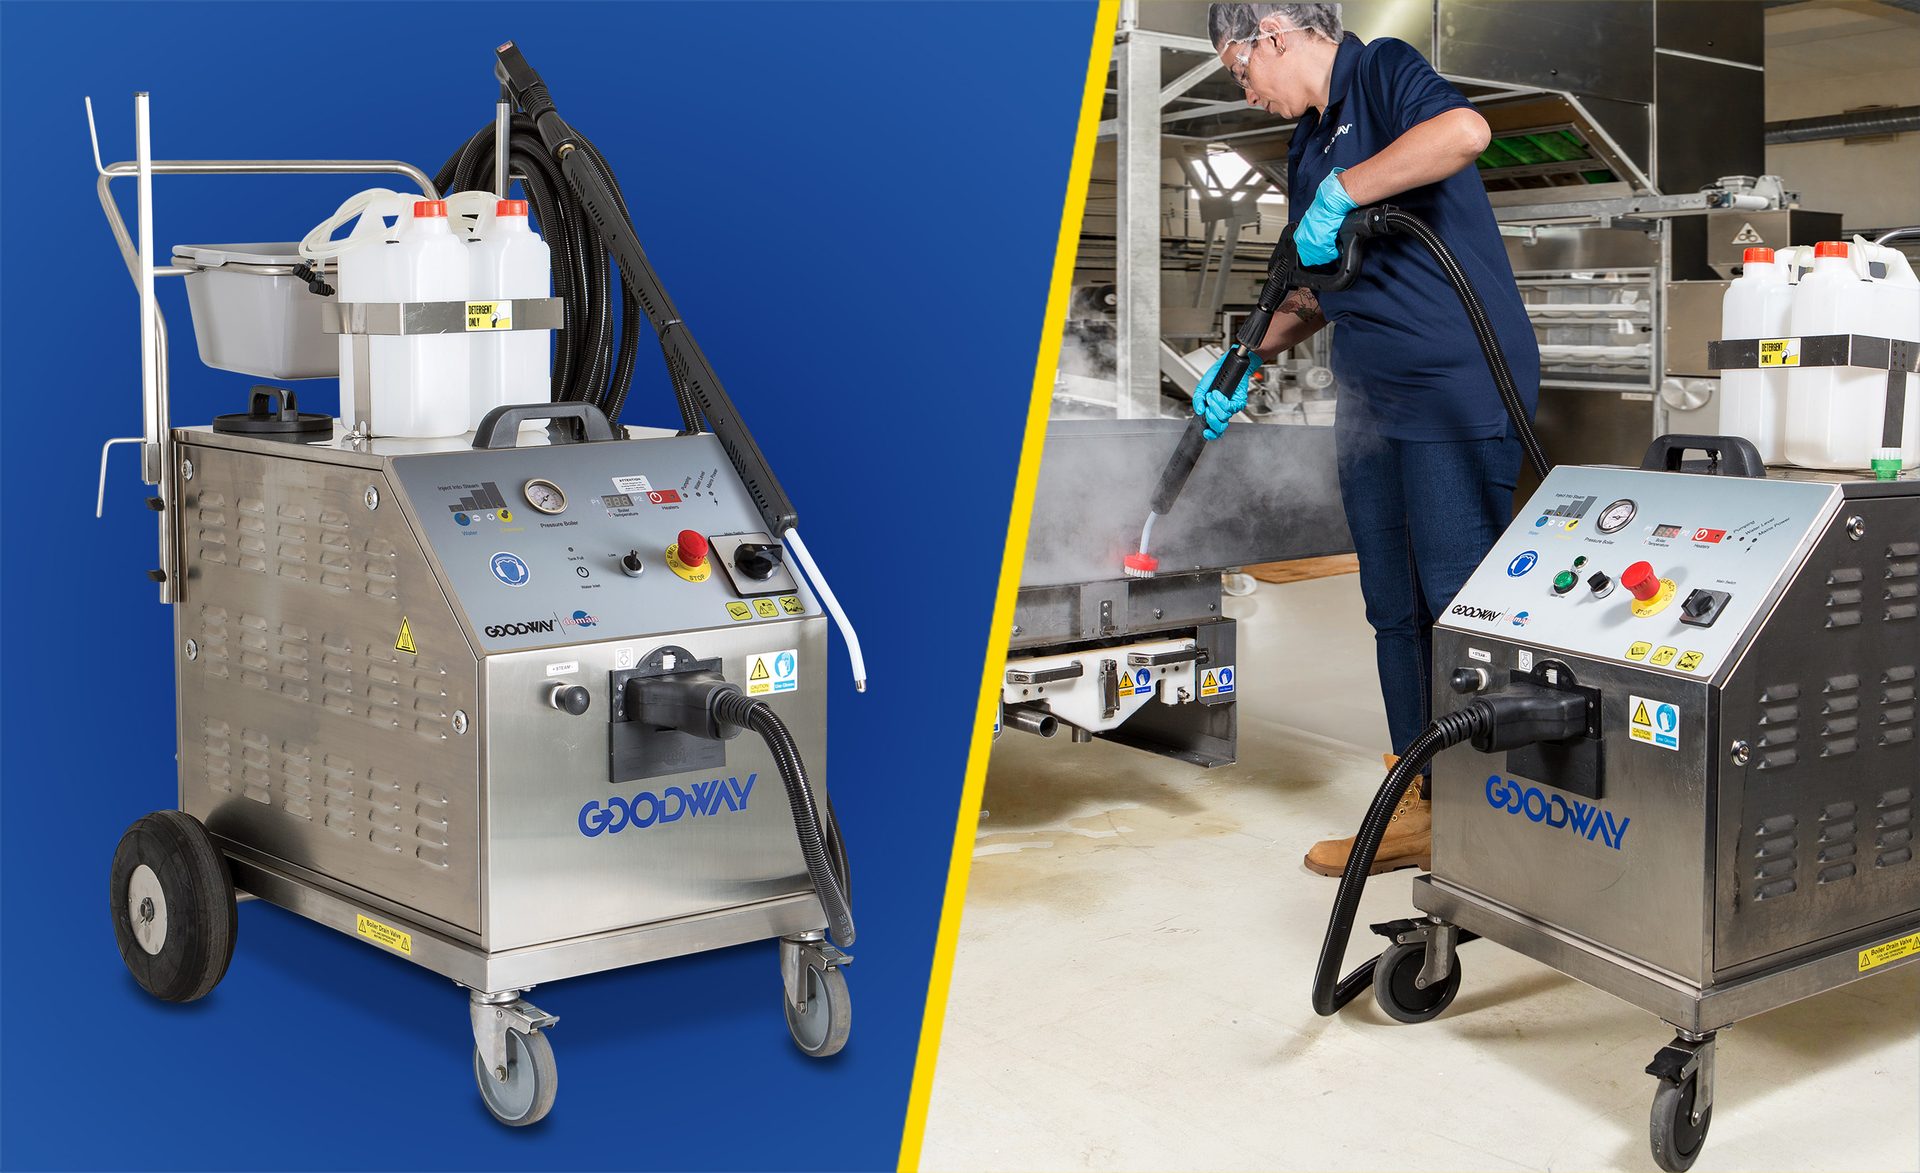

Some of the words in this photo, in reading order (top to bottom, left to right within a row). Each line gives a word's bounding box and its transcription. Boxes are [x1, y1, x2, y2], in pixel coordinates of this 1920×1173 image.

[468, 304, 492, 314] DETERGENT
[468, 318, 480, 326] ONLY
[1762, 342, 1783, 352] DETERGENT
[1762, 354, 1772, 364] ONLY
[1733, 520, 1756, 534] Pumping
[1745, 525, 1760, 535] Water
[1761, 517, 1775, 527] Level
[1774, 517, 1790, 528] Power
[1452, 604, 1501, 622] GOODWAY
[485, 620, 554, 638] GOODWAY
[578, 774, 757, 838] GOODWAY
[1486, 775, 1630, 850] GOODWAY
[366, 920, 378, 929] Boiler
[379, 924, 389, 934] Drain
[390, 929, 401, 939] Valve
[1871, 947, 1885, 956] Boiler
[1886, 942, 1899, 950] Drain
